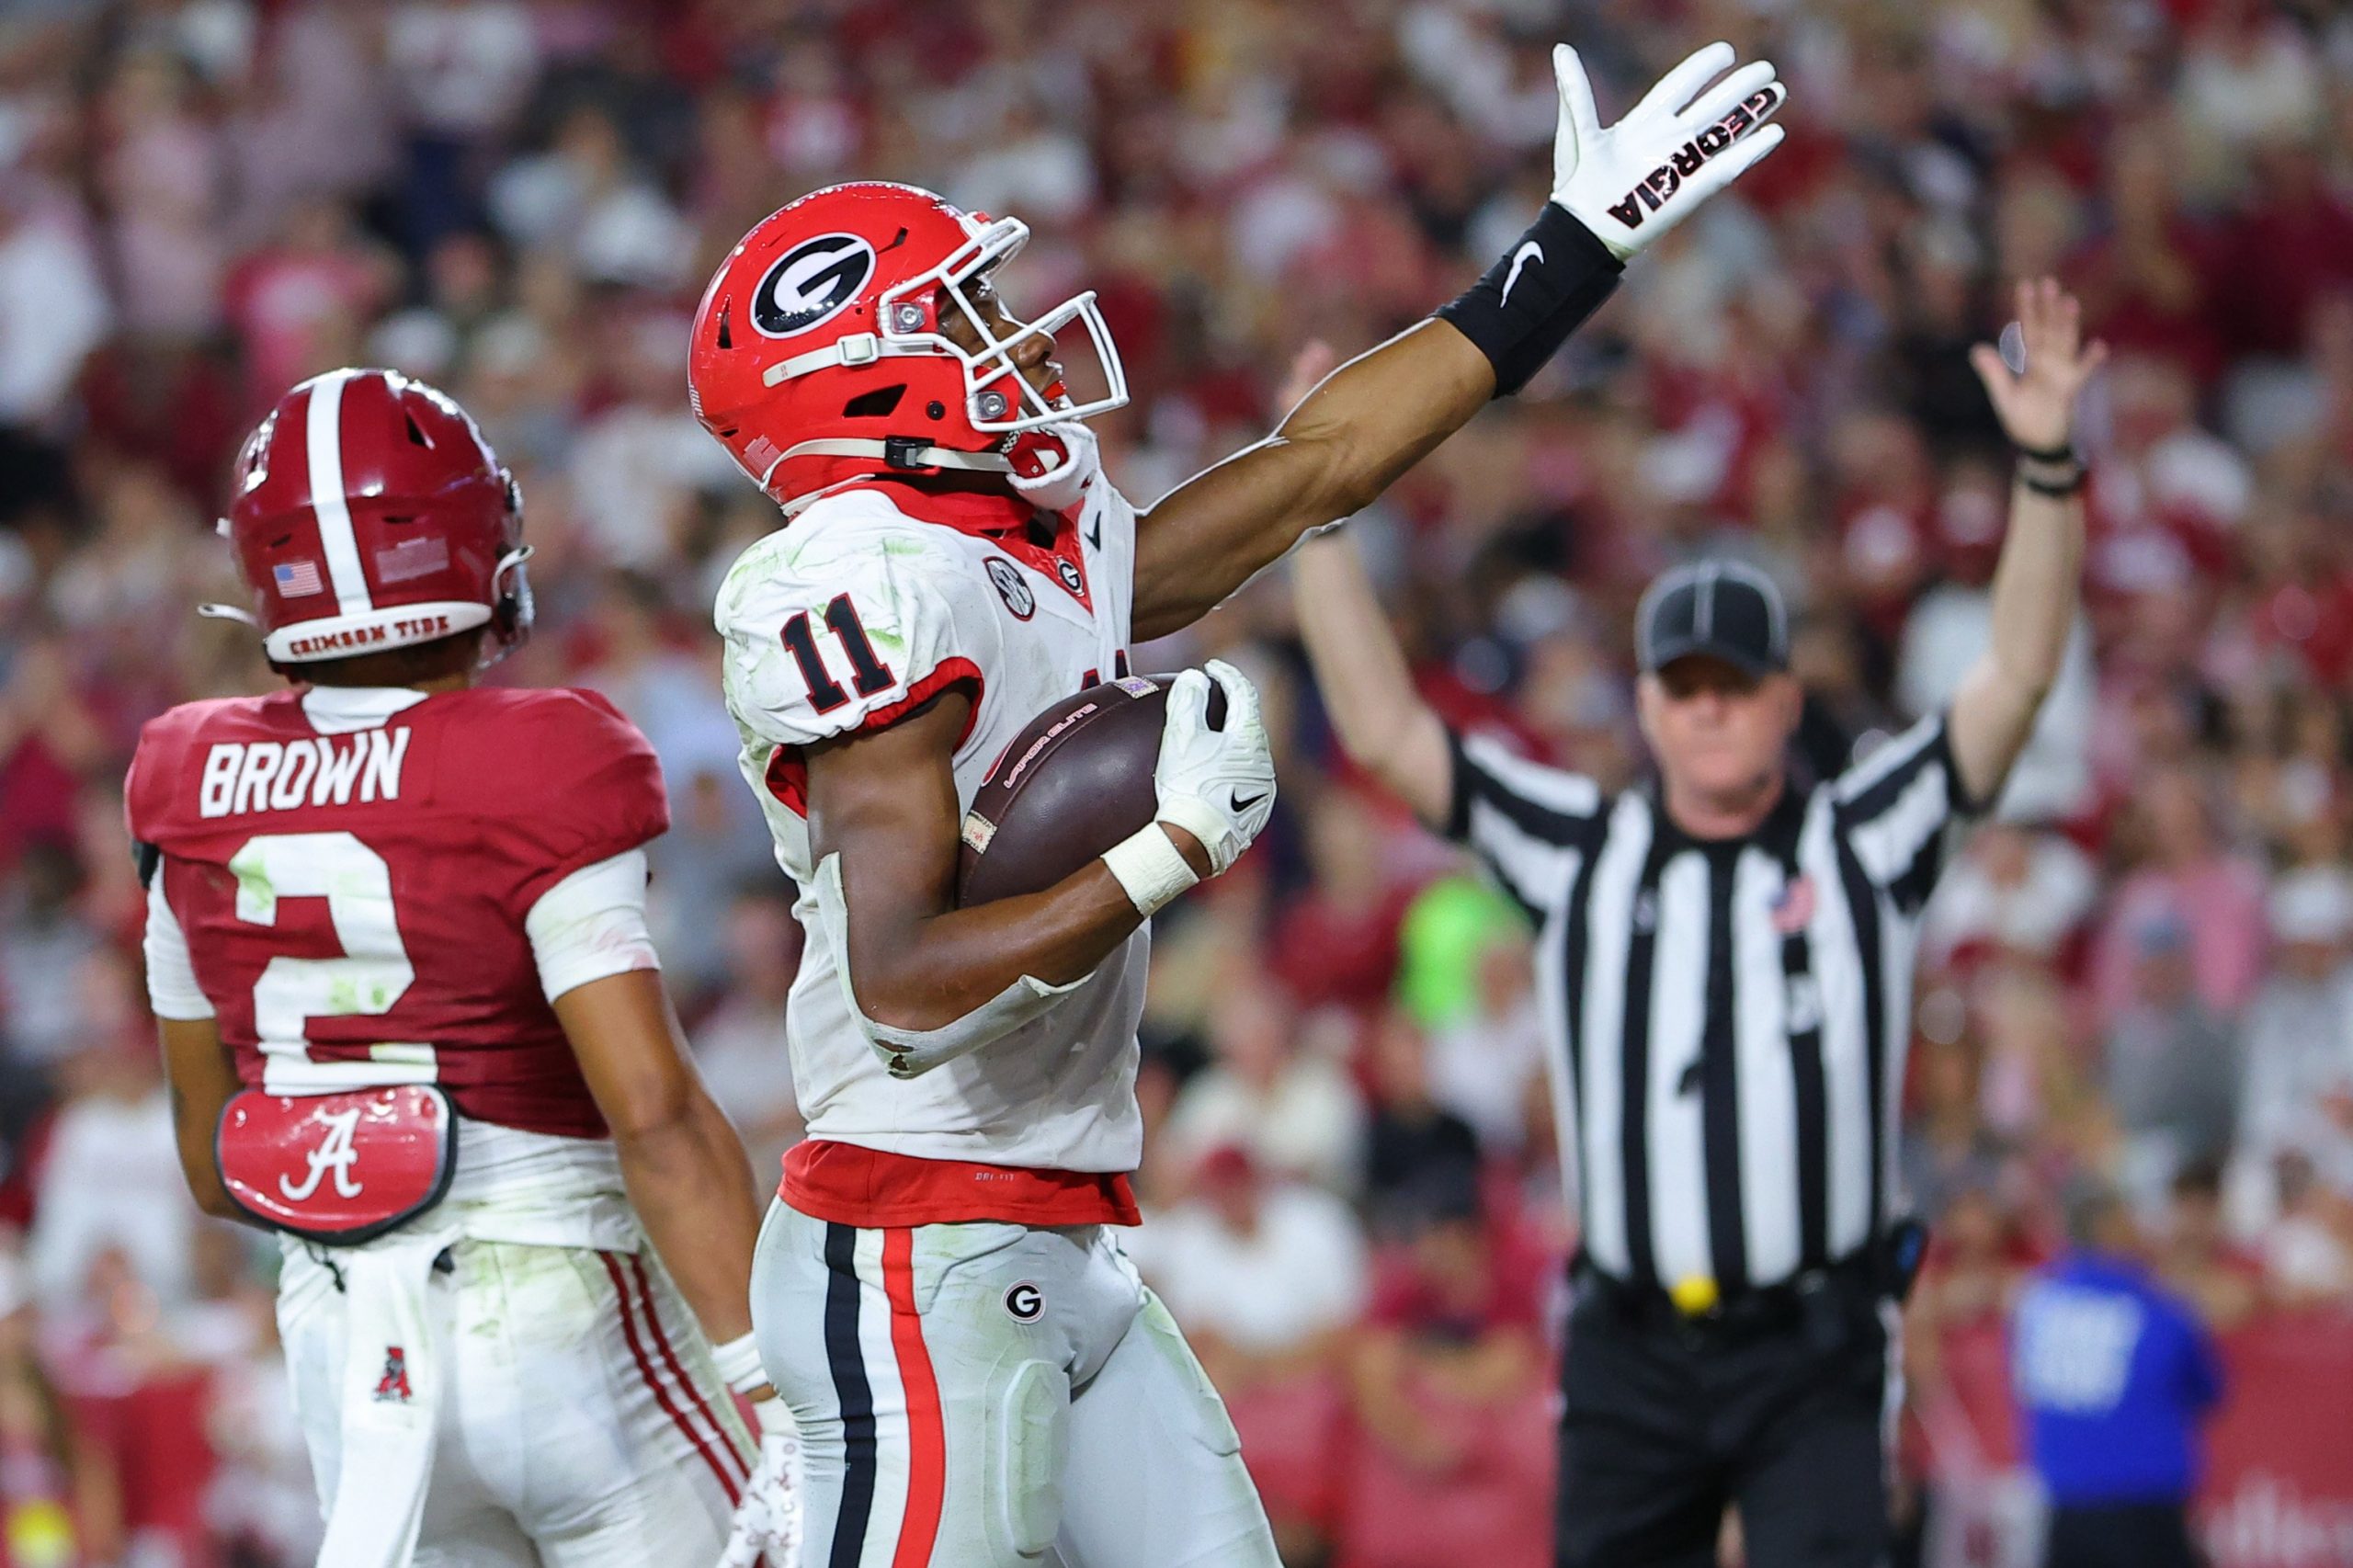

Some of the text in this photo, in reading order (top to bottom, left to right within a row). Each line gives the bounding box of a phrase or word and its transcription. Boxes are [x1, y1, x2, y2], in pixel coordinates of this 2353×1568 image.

[1606, 86, 1779, 230] GEORGIA
[753, 234, 873, 335] G
[1058, 561, 1083, 592] G
[289, 614, 449, 656] CRIMSON TIDE
[779, 591, 898, 716] 11
[1047, 702, 1098, 738] ELITE
[199, 726, 412, 819] BROWN
[228, 830, 439, 1096] 2
[278, 1106, 364, 1201] A
[1004, 1282, 1043, 1321] G
